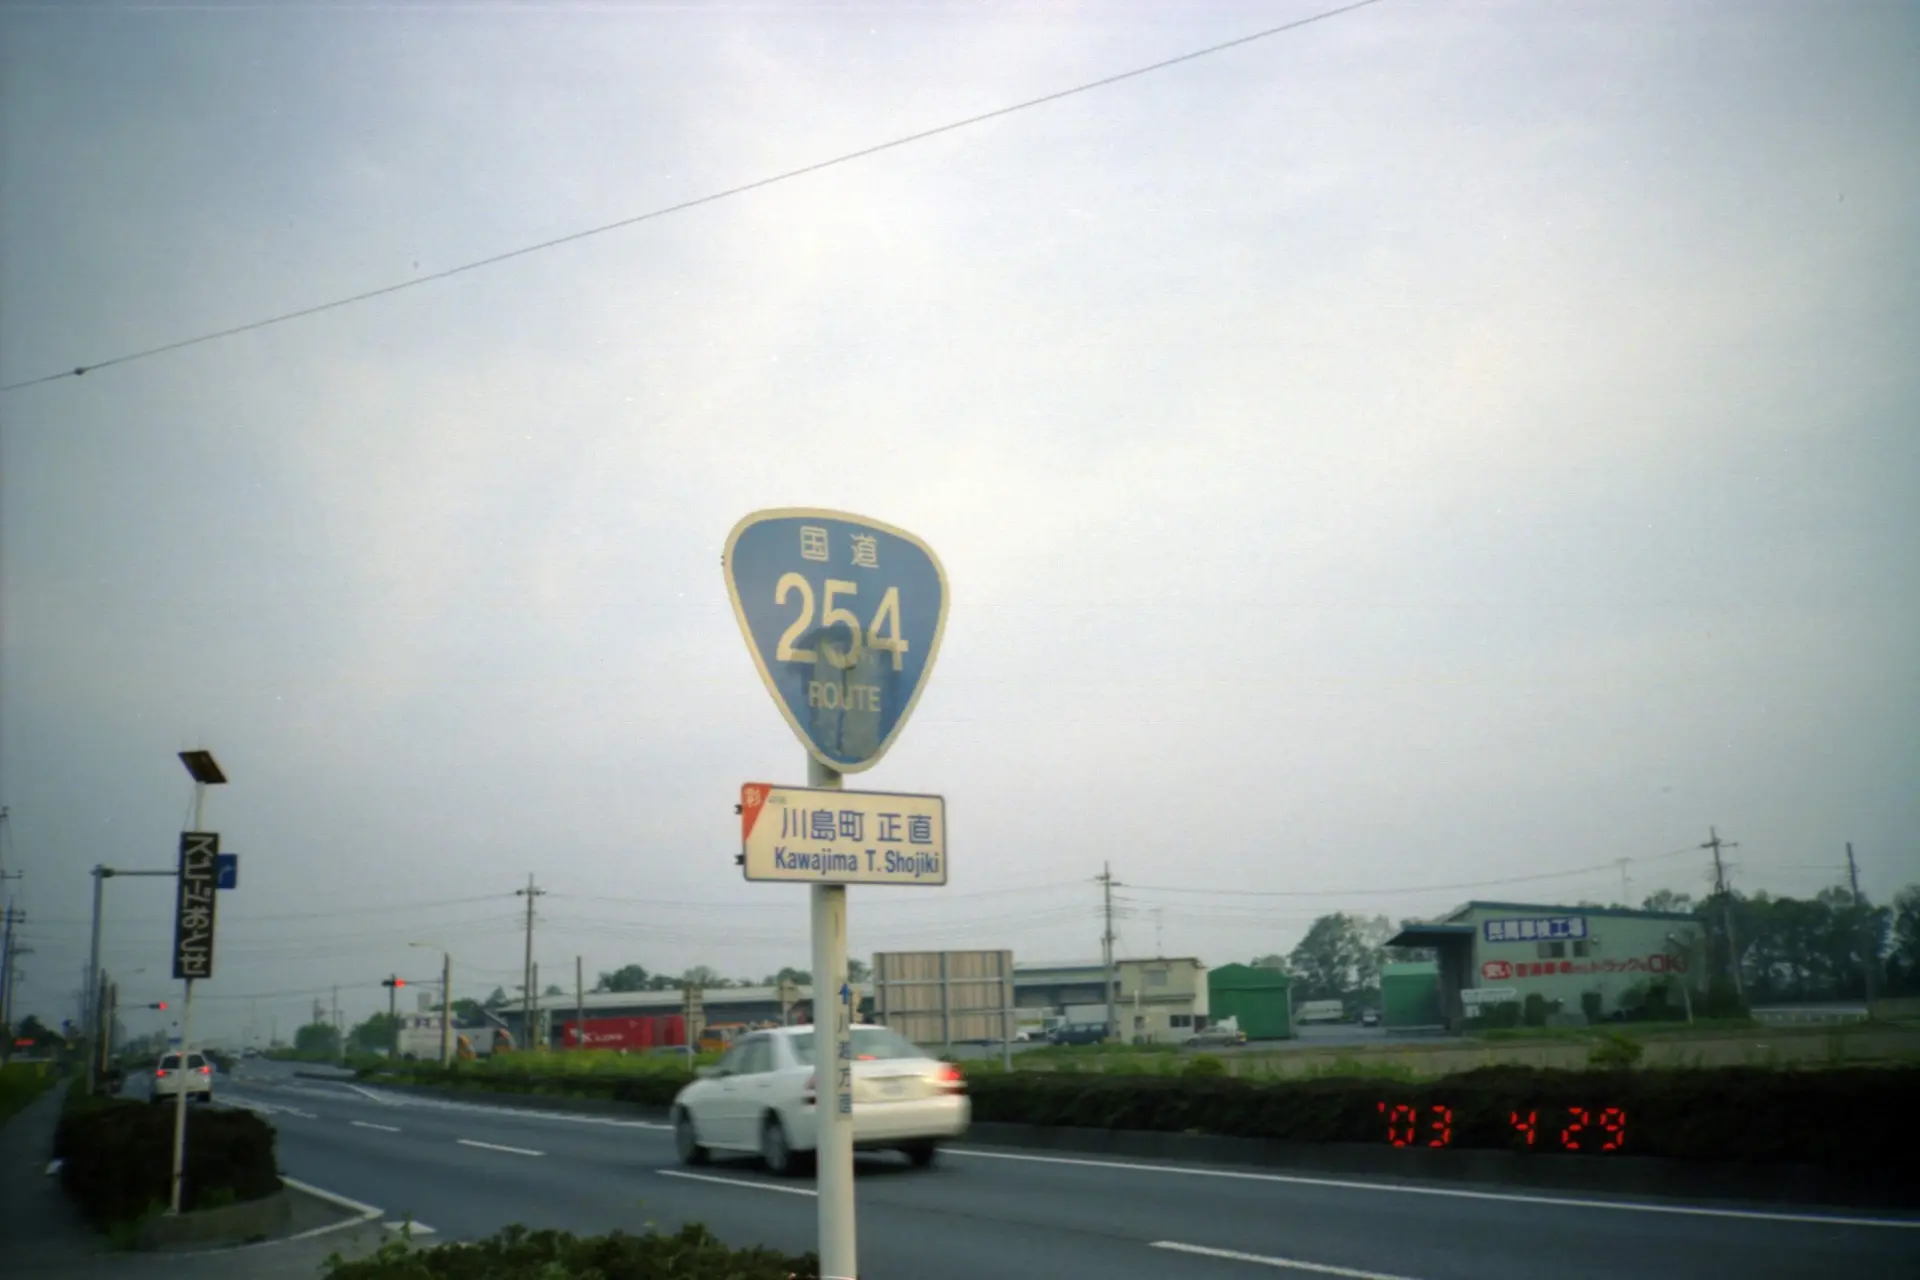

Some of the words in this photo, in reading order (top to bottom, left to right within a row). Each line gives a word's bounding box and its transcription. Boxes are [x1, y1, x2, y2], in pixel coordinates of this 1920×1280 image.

[801, 525, 879, 568] 国道
[775, 571, 909, 671] 254
[808, 680, 881, 712] ROUTE
[781, 807, 865, 842] 川島町
[876, 812, 933, 844] 正直
[774, 846, 858, 875] Kawajima
[179, 835, 215, 976] スピードおとせ
